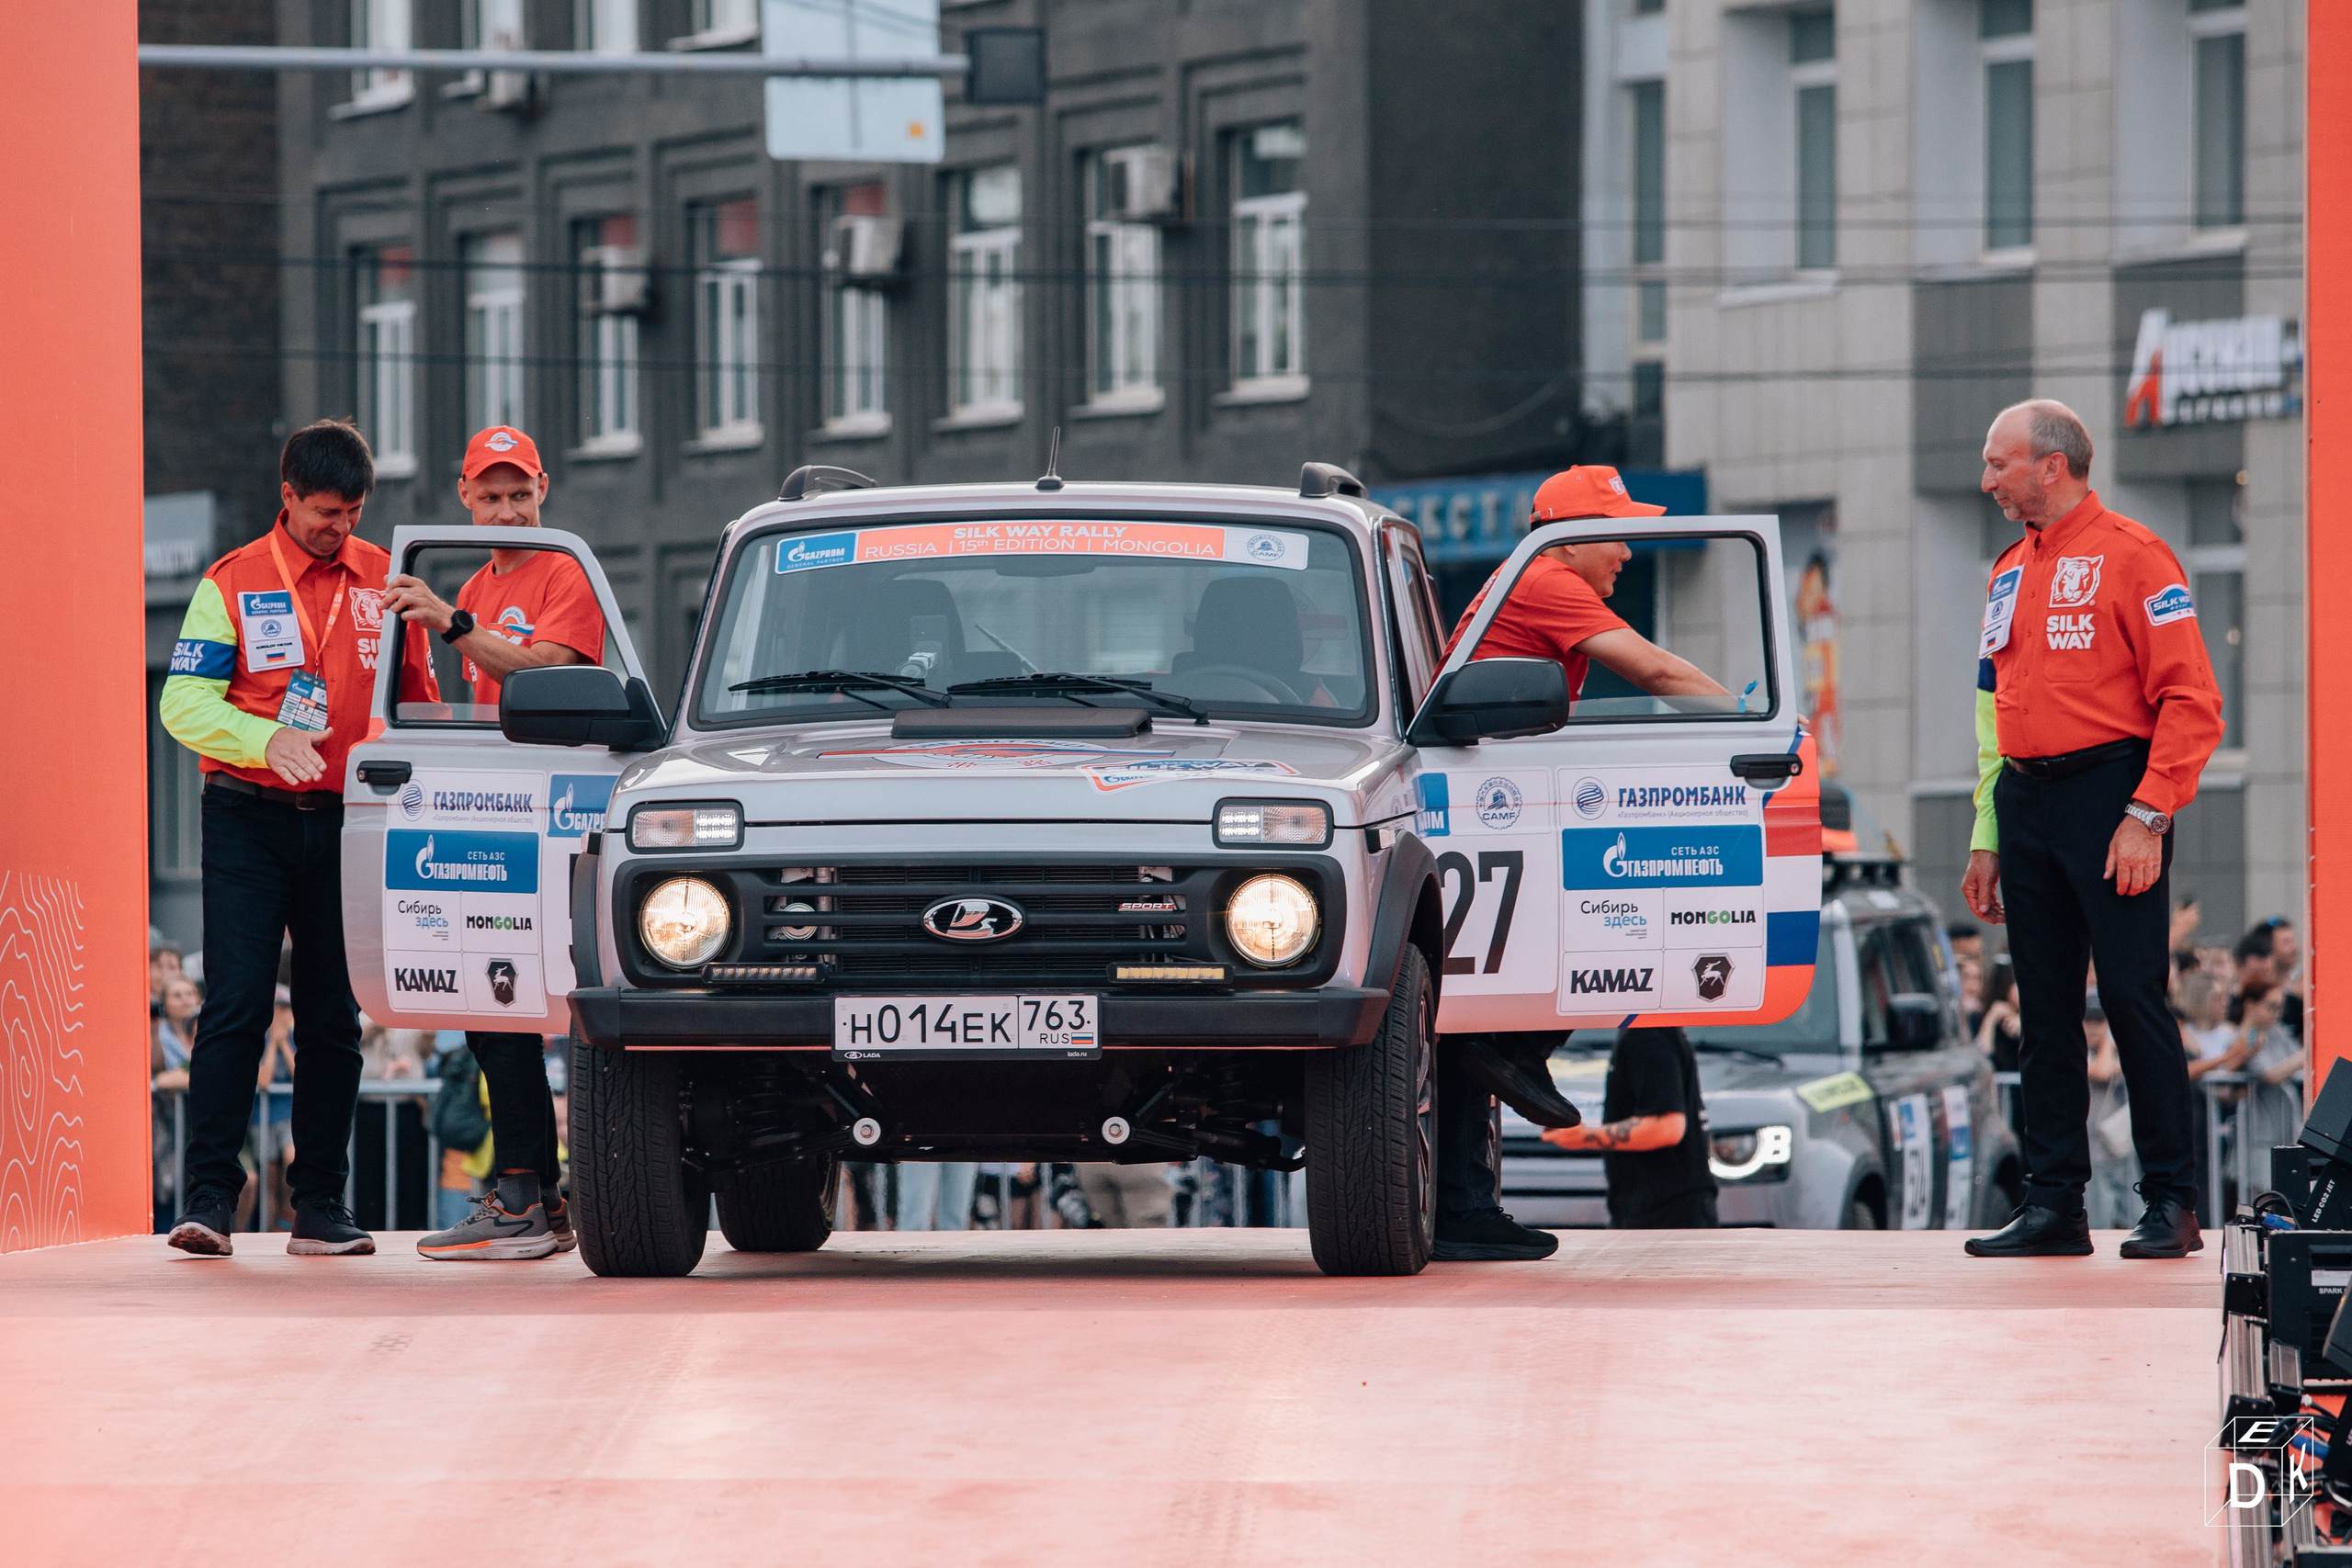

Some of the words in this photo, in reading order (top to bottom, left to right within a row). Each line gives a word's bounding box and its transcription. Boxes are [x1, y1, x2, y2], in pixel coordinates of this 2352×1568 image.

[954, 526, 1000, 539] SILK
[1006, 525, 1056, 537] WAY
[1059, 525, 1127, 537] RALLY
[804, 547, 845, 560] GAZPROM
[865, 542, 937, 558] RUSSIA
[959, 539, 989, 552] 15th
[994, 538, 1075, 551] EDITION
[1103, 538, 1216, 557] MONGOLIA
[2153, 597, 2178, 612] SILK
[2046, 614, 2096, 633] SILK
[357, 637, 380, 654] SI
[2047, 631, 2096, 650] WAY
[173, 642, 205, 658] SILK
[171, 657, 202, 671] WAY
[434, 791, 533, 812] ГАЗПРОМБАНК
[1618, 785, 1747, 807] ГАЗПРОМБАНК
[1482, 812, 1516, 820] CAMF
[468, 852, 488, 861] СЕТЬ
[489, 852, 505, 861] АЗС
[1671, 846, 1698, 856] СЕТЬ
[1700, 845, 1720, 855] АЗС
[434, 863, 508, 882] ГАЗПРОМНЕФТЬ
[1627, 858, 1724, 878] ГАЗПРОМНЕФТЬ
[398, 900, 442, 918] Сибирь
[1439, 850, 1523, 976] 27
[1580, 900, 1639, 917] Сибирь
[415, 916, 449, 930] здесь
[466, 915, 533, 931] MONGOLIA
[1603, 914, 1647, 929] здесь
[1670, 910, 1757, 925] MONGOLIA
[394, 967, 458, 994] KAMAZ
[1570, 967, 1655, 994] KAMAZ
[1023, 1000, 1085, 1031] 763
[1039, 1033, 1069, 1044] RUS
[2312, 1208, 2323, 1224] LED
[2318, 1191, 2330, 1208] CO2
[2327, 1179, 2336, 1193] JET
